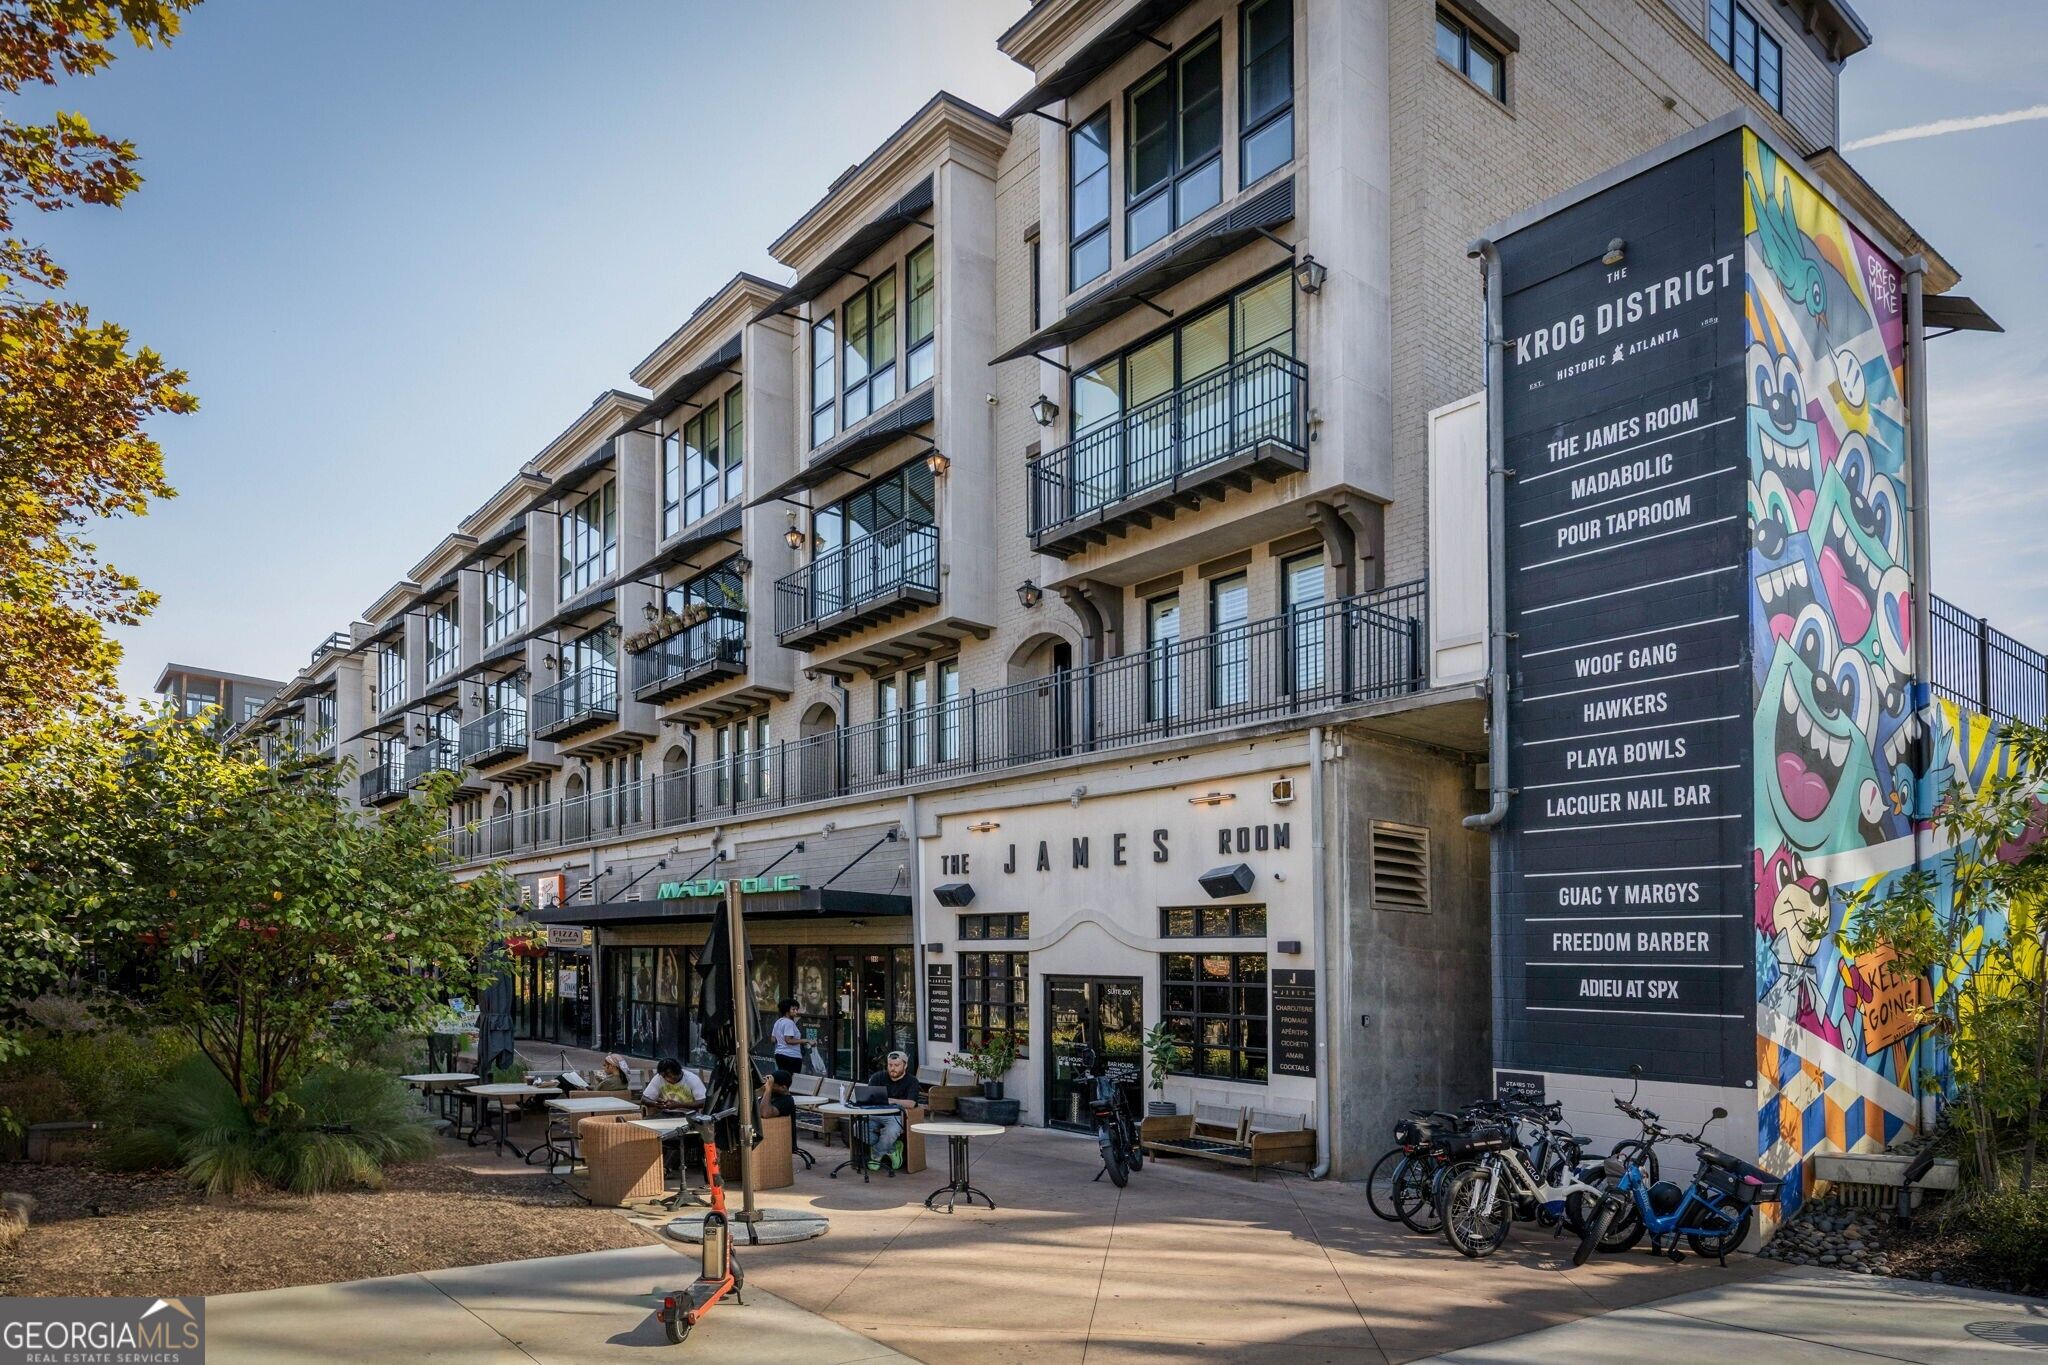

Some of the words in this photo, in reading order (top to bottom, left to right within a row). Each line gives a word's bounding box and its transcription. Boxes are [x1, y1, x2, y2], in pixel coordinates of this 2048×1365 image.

[1606, 267, 1628, 284] THE
[1868, 255, 1896, 294] GREG
[1517, 314, 1585, 366] KROG
[1597, 254, 1734, 335] DISTRICT
[1869, 276, 1898, 314] MIKE
[1557, 354, 1606, 381] HISTORIC
[1629, 328, 1680, 355] ATLANTA
[1548, 435, 1579, 462] THE
[1584, 416, 1640, 452] JAMES
[1645, 398, 1699, 434] ROOM
[1571, 453, 1673, 500] MADABOLIC
[1557, 519, 1601, 548] POUR
[1605, 494, 1692, 536] TAPROOM
[1574, 652, 1624, 678] WOOF
[1628, 642, 1677, 669] GANG
[1583, 692, 1668, 723] HAWKERS
[1566, 746, 1618, 770] PLAYA
[1623, 738, 1686, 764] BOWLS
[1546, 792, 1622, 818] LACQUER
[1626, 788, 1668, 811] NAIL
[1674, 784, 1712, 806] BAR
[940, 852, 970, 876] THE
[1004, 829, 1168, 874] JAMES
[1218, 822, 1290, 854] ROOM
[657, 874, 800, 900] MADAOLIC
[1558, 886, 1602, 906] GUAC
[1607, 886, 1619, 905] Y
[1624, 882, 1700, 905] MARGYS
[1552, 932, 1631, 952] FREEDOM
[1636, 932, 1710, 952] BARBER
[1290, 972, 1296, 984] J
[1579, 978, 1623, 998] ADIEU
[1626, 980, 1644, 998] AT
[1648, 980, 1680, 1000] SPX
[1868, 962, 1904, 992] KEE
[1868, 990, 1914, 1030] GOING
[1280, 1064, 1310, 1072] COCKTAILS
[1524, 1160, 1540, 1181] EVELO
